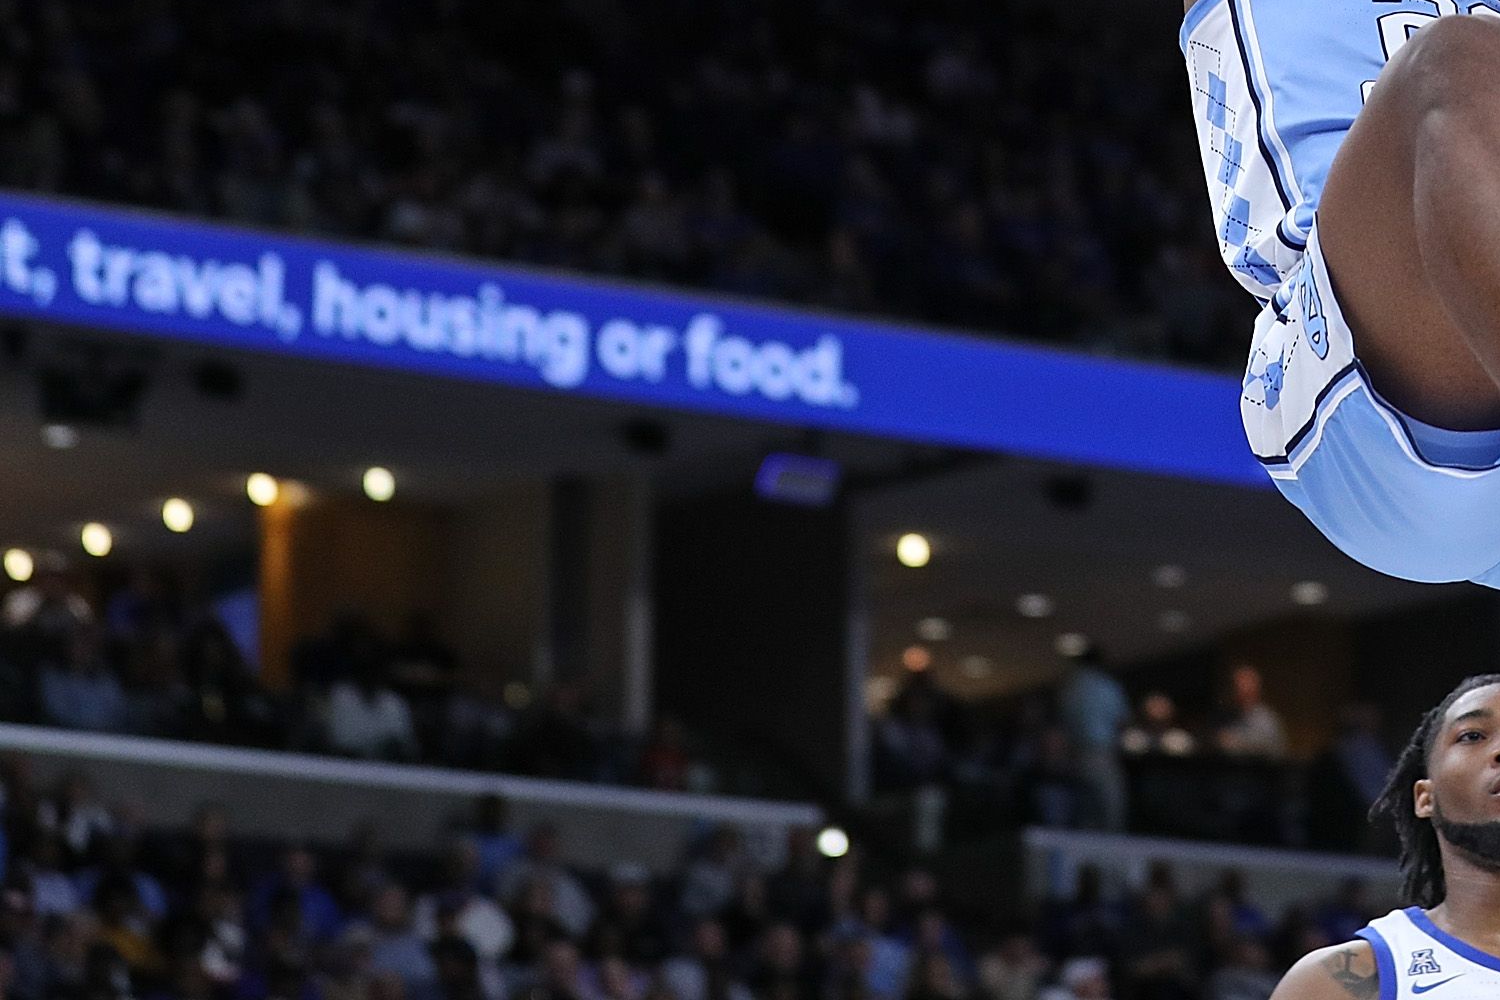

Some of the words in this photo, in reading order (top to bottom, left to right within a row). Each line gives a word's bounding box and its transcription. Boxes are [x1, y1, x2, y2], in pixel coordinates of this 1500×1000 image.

[70, 229, 301, 340] travel,
[312, 262, 588, 388] housing
[597, 320, 675, 382] or
[685, 315, 859, 409] food.
